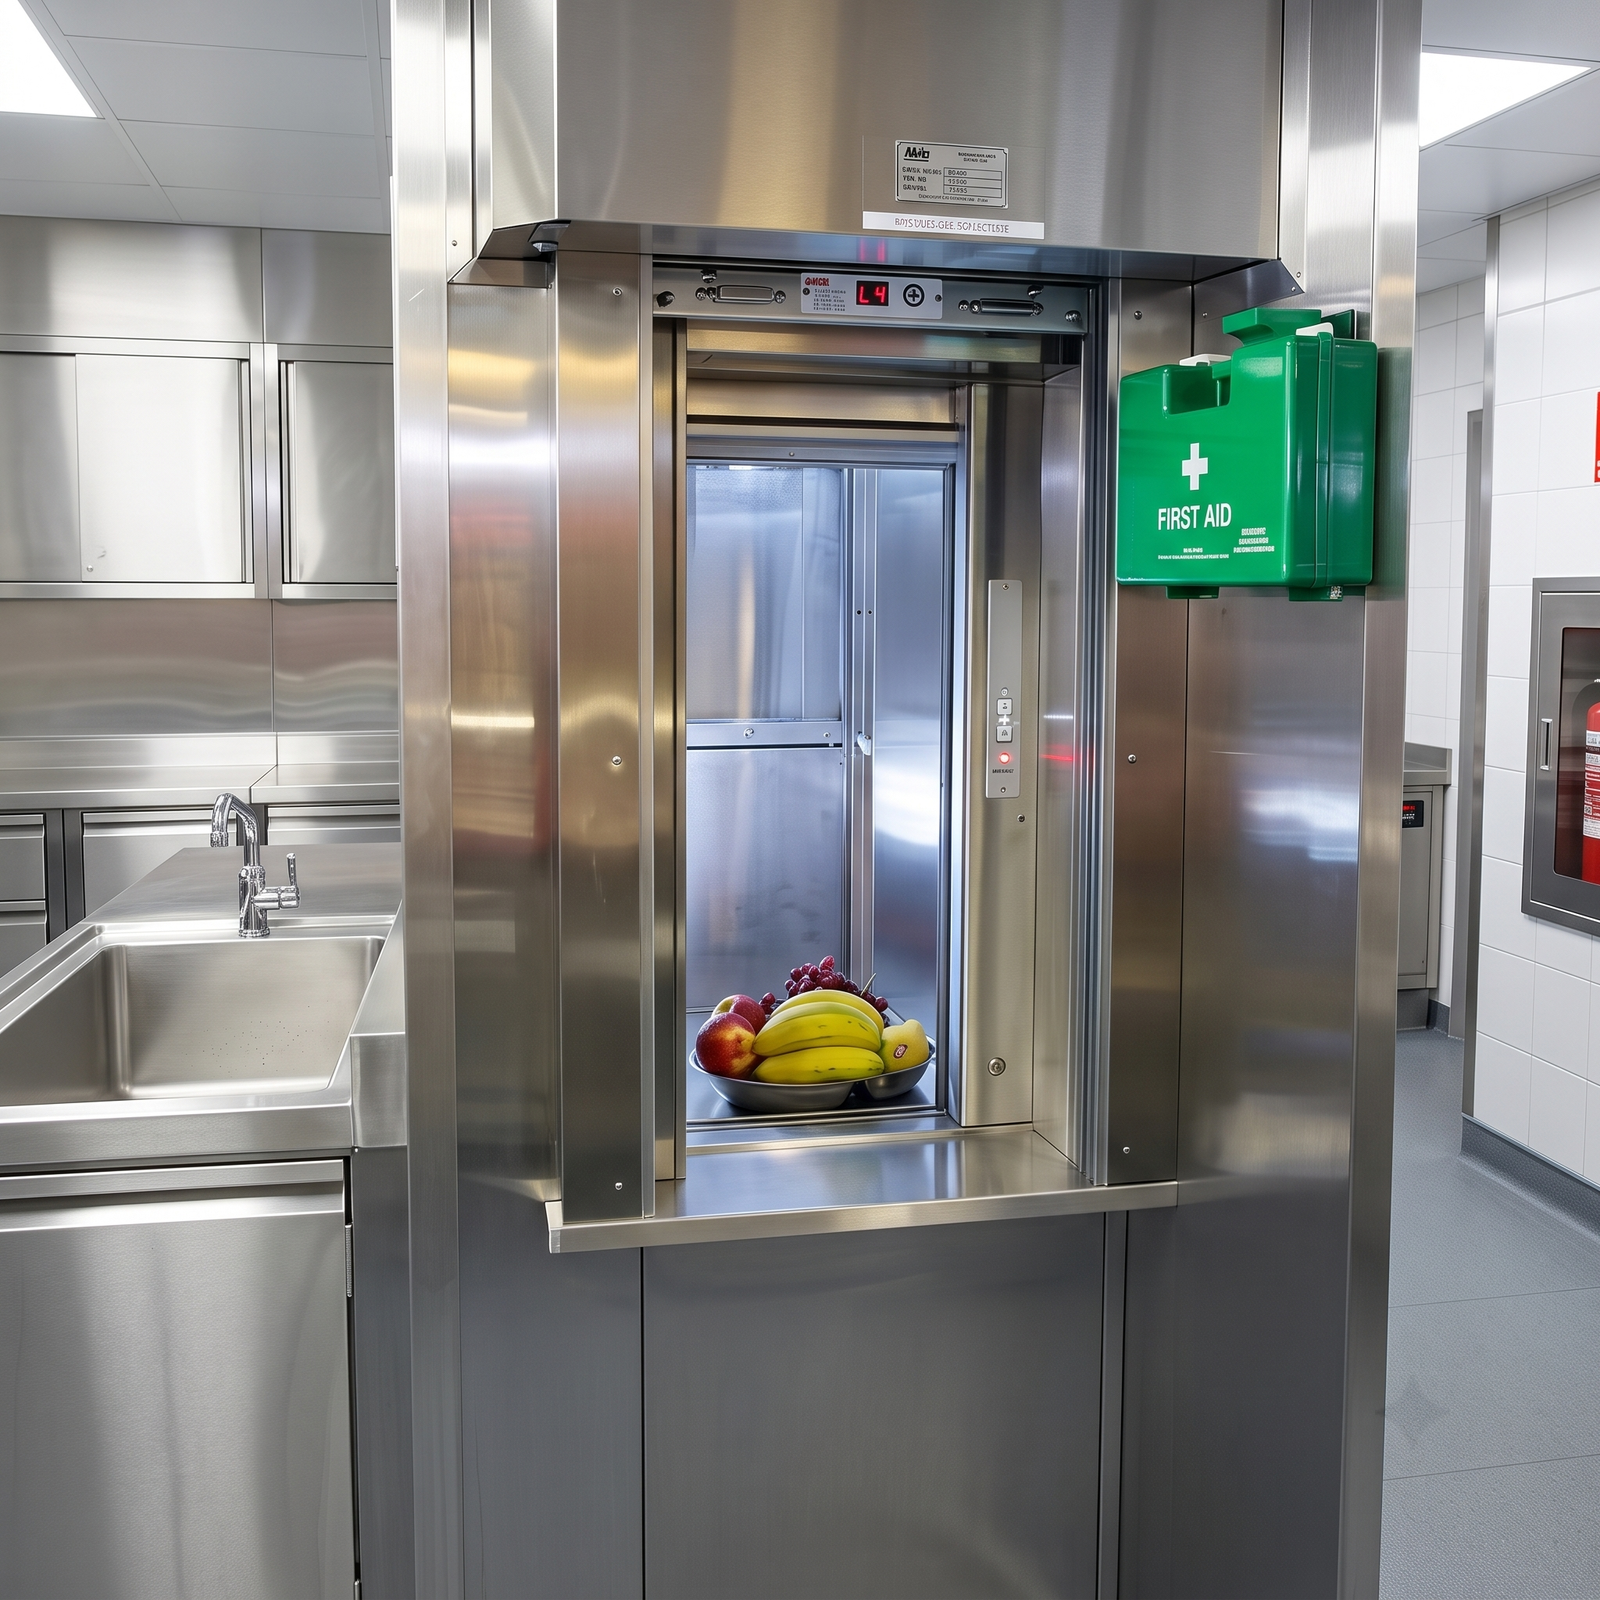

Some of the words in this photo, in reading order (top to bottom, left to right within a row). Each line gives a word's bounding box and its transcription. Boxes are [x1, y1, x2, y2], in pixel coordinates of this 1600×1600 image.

[860, 286, 886, 304] L4
[1158, 505, 1200, 531] FIRST
[1203, 502, 1232, 528] AID
